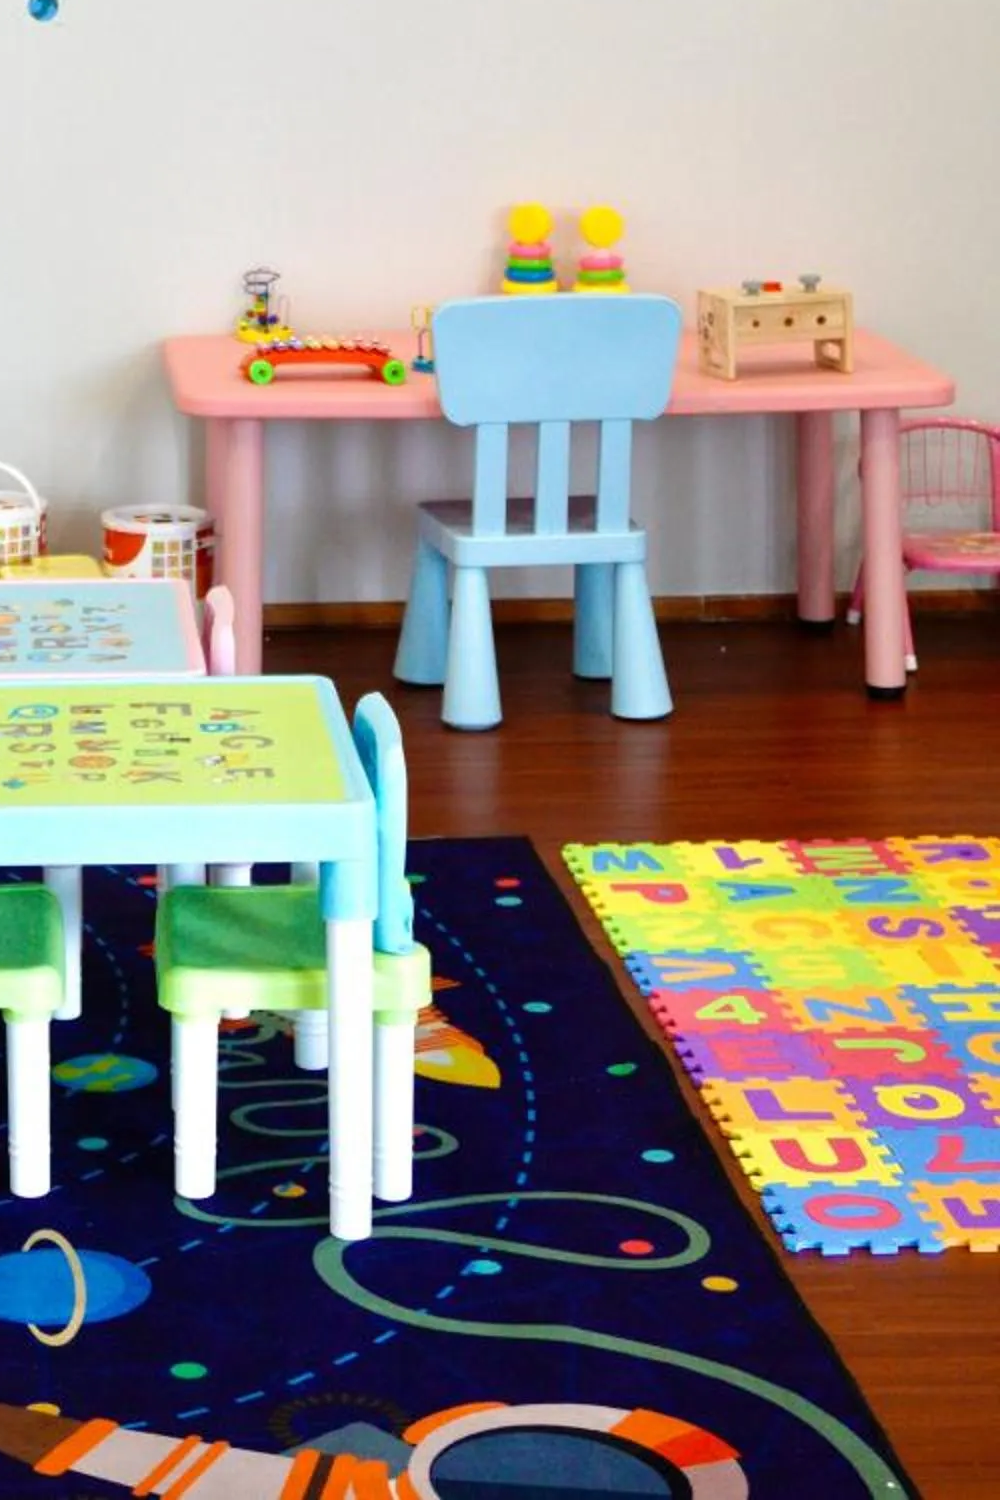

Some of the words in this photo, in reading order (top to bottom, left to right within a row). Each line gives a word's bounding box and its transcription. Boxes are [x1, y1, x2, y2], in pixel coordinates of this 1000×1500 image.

[911, 843, 991, 864] R
[609, 883, 689, 905] P
[716, 881, 796, 902] A
[752, 916, 833, 939] C
[867, 916, 945, 938] S
[651, 956, 737, 983] V
[695, 995, 768, 1025] 4
[833, 1038, 927, 1063] J
[742, 1089, 836, 1121] L
[770, 1137, 868, 1173] U
